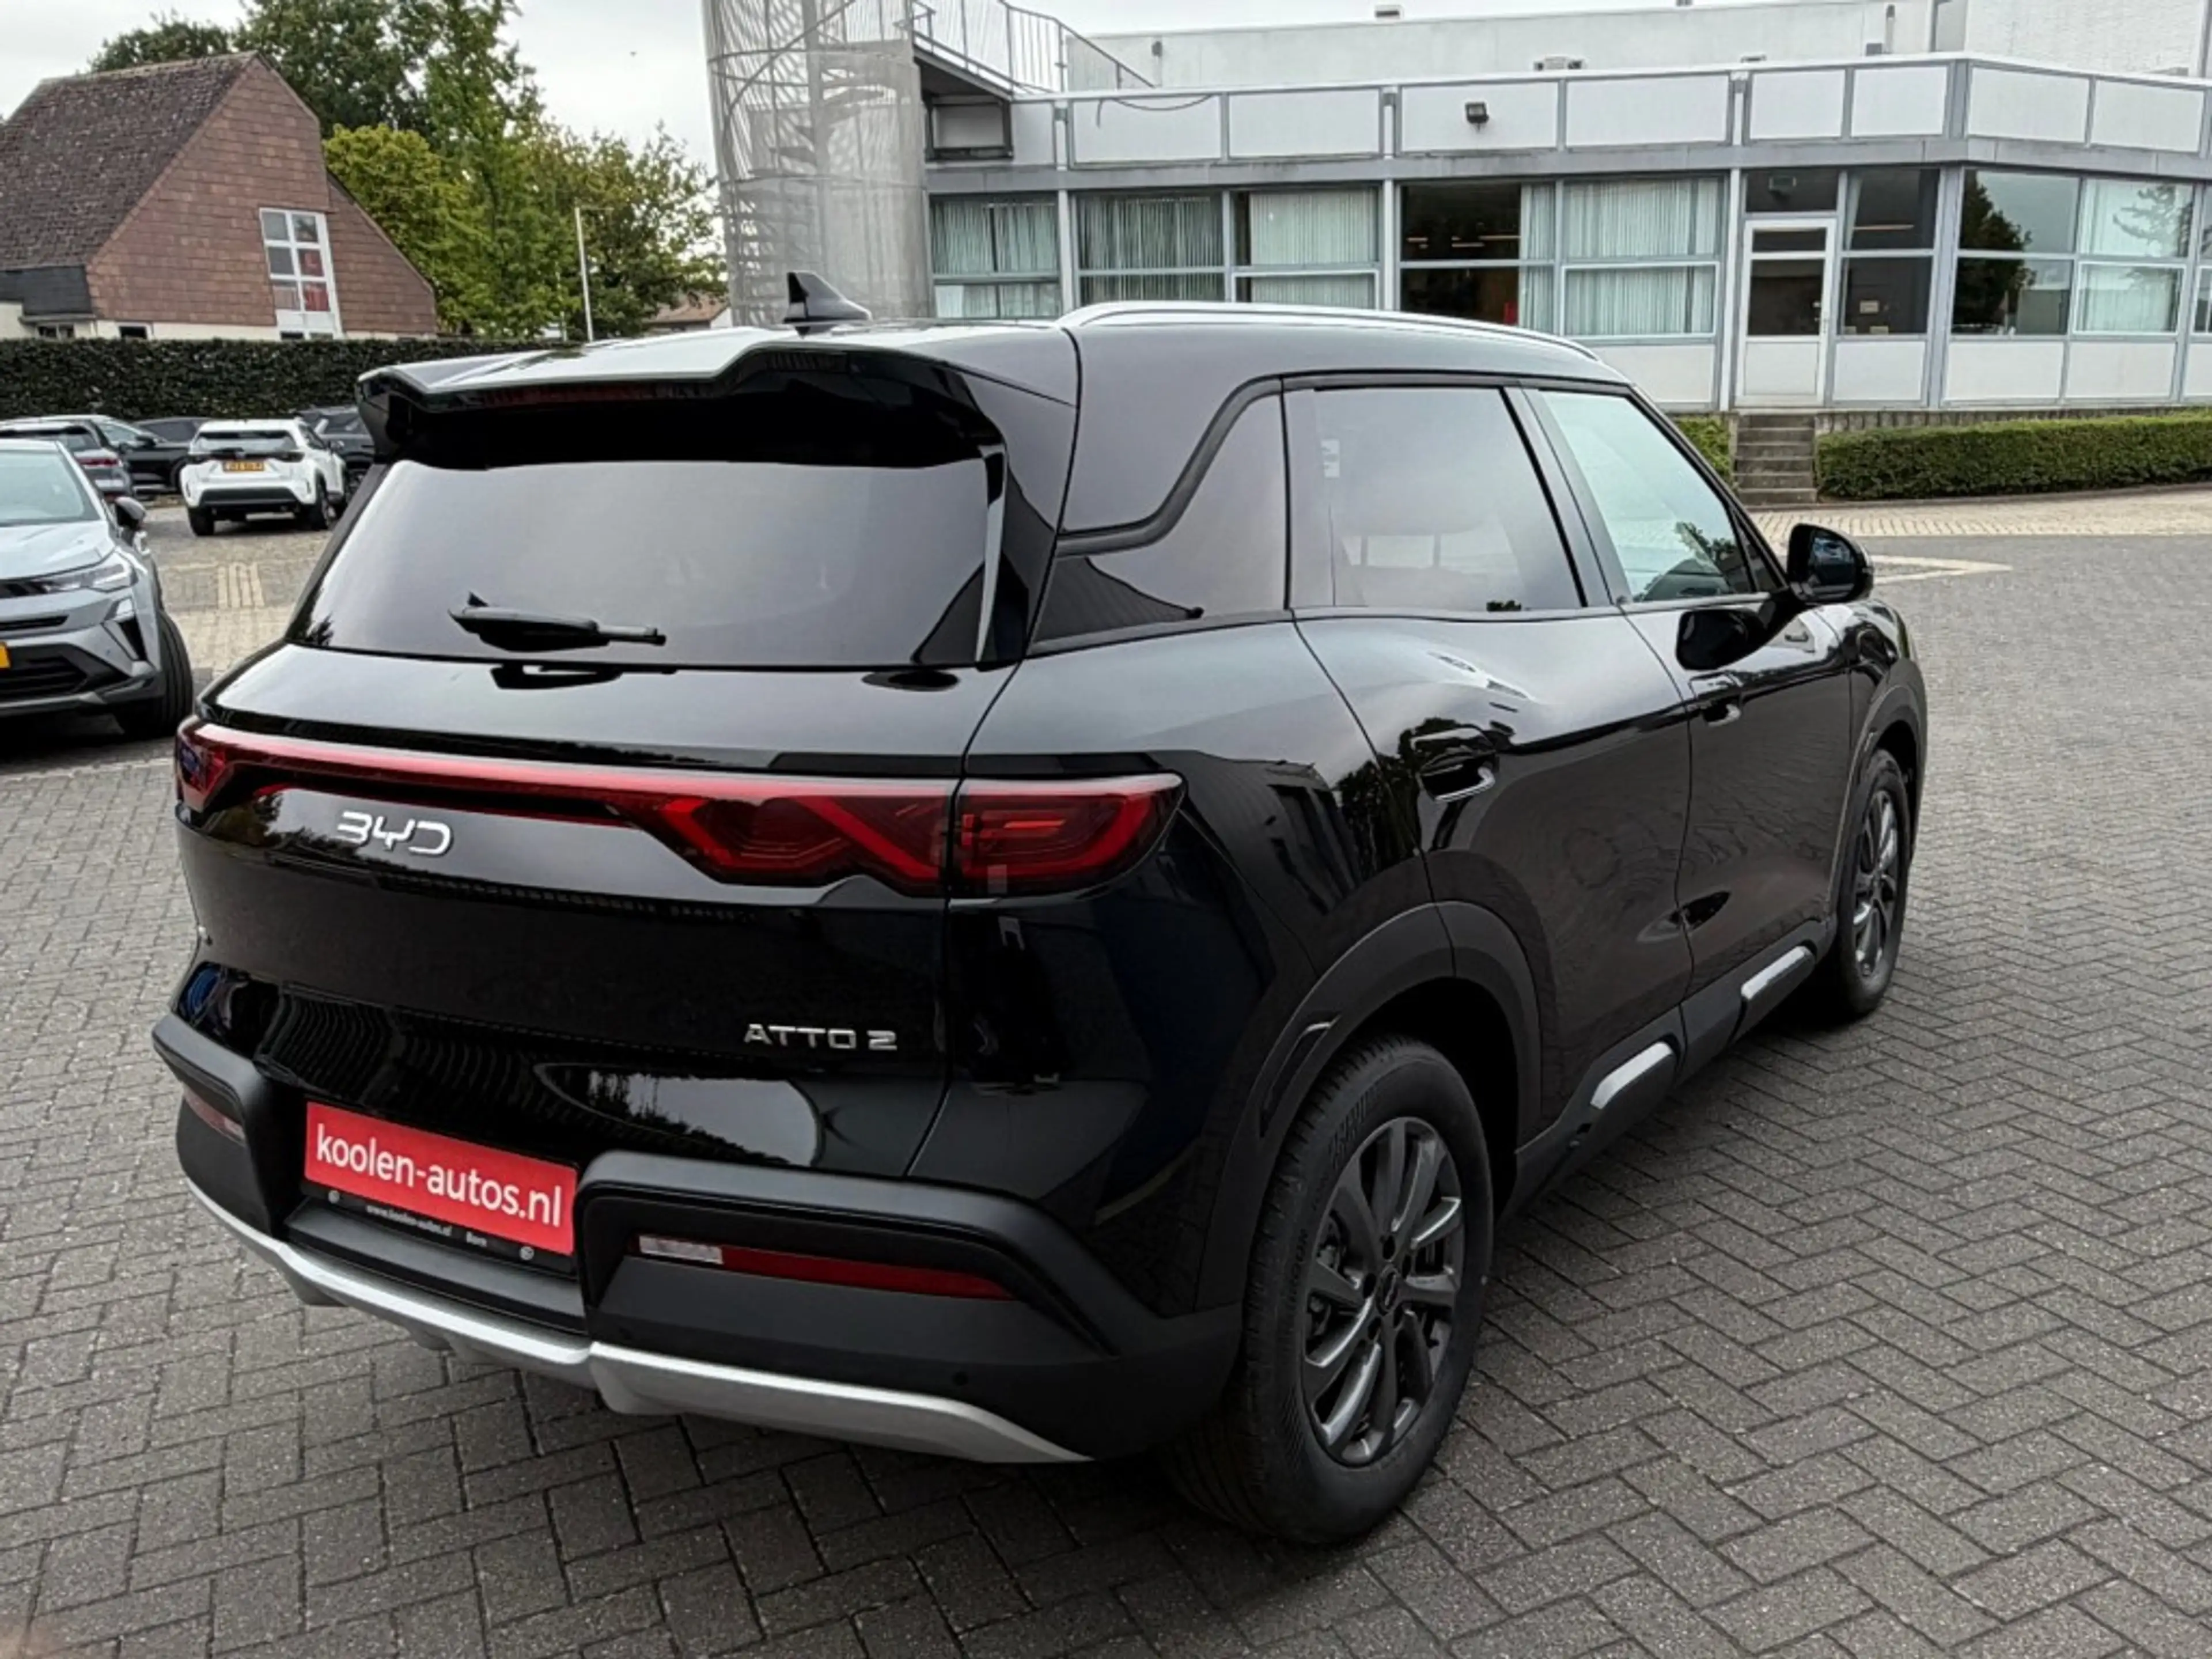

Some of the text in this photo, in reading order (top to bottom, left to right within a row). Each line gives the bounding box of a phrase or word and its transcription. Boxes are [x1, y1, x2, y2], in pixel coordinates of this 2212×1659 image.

[336, 810, 451, 855] BYD
[744, 1023, 897, 1051] ATTO 2
[316, 1123, 562, 1228] koolen-autos.nl
